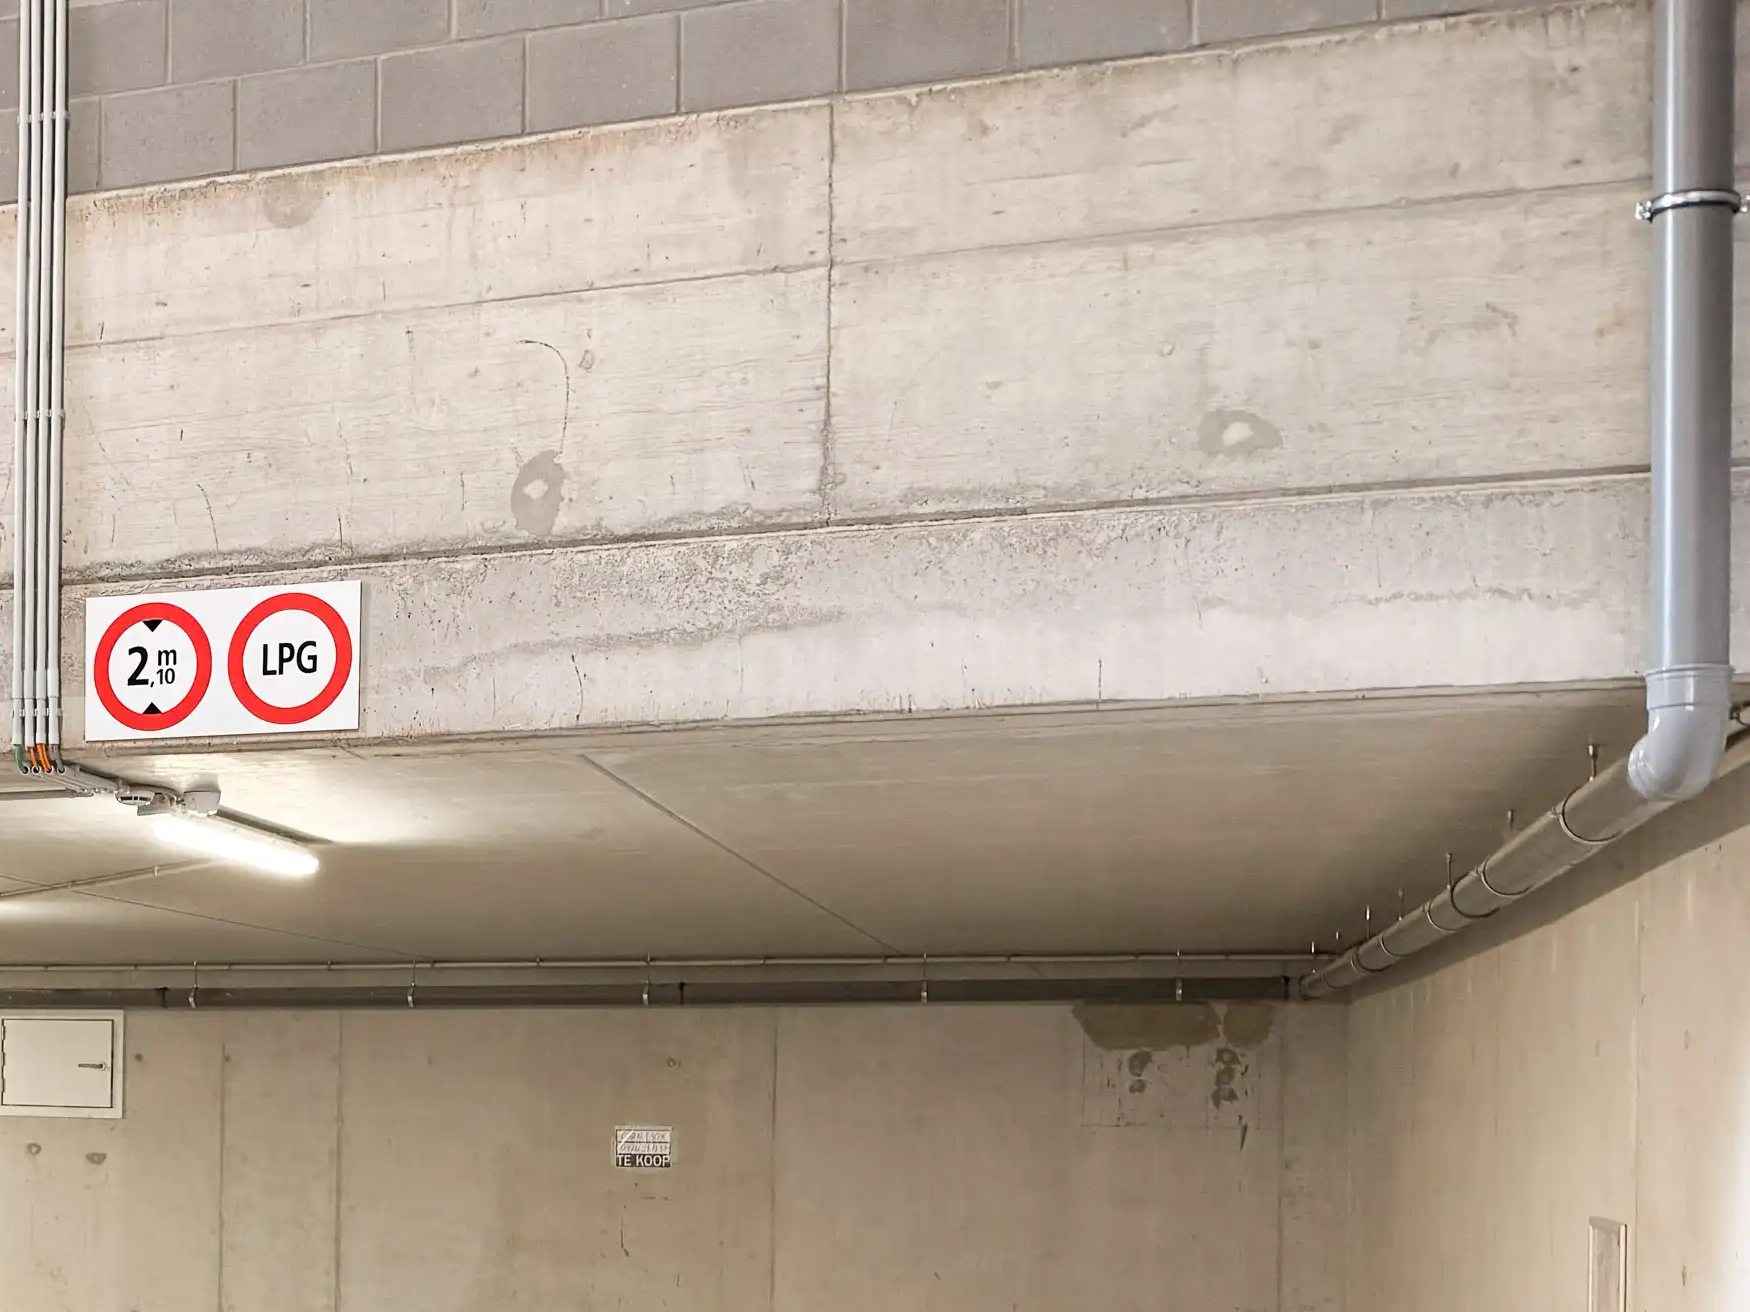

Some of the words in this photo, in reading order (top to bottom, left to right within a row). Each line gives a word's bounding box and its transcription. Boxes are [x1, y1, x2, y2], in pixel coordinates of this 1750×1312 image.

[262, 640, 318, 677] LPG
[616, 1154, 632, 1167] TE
[635, 1154, 671, 1167] KOOP
